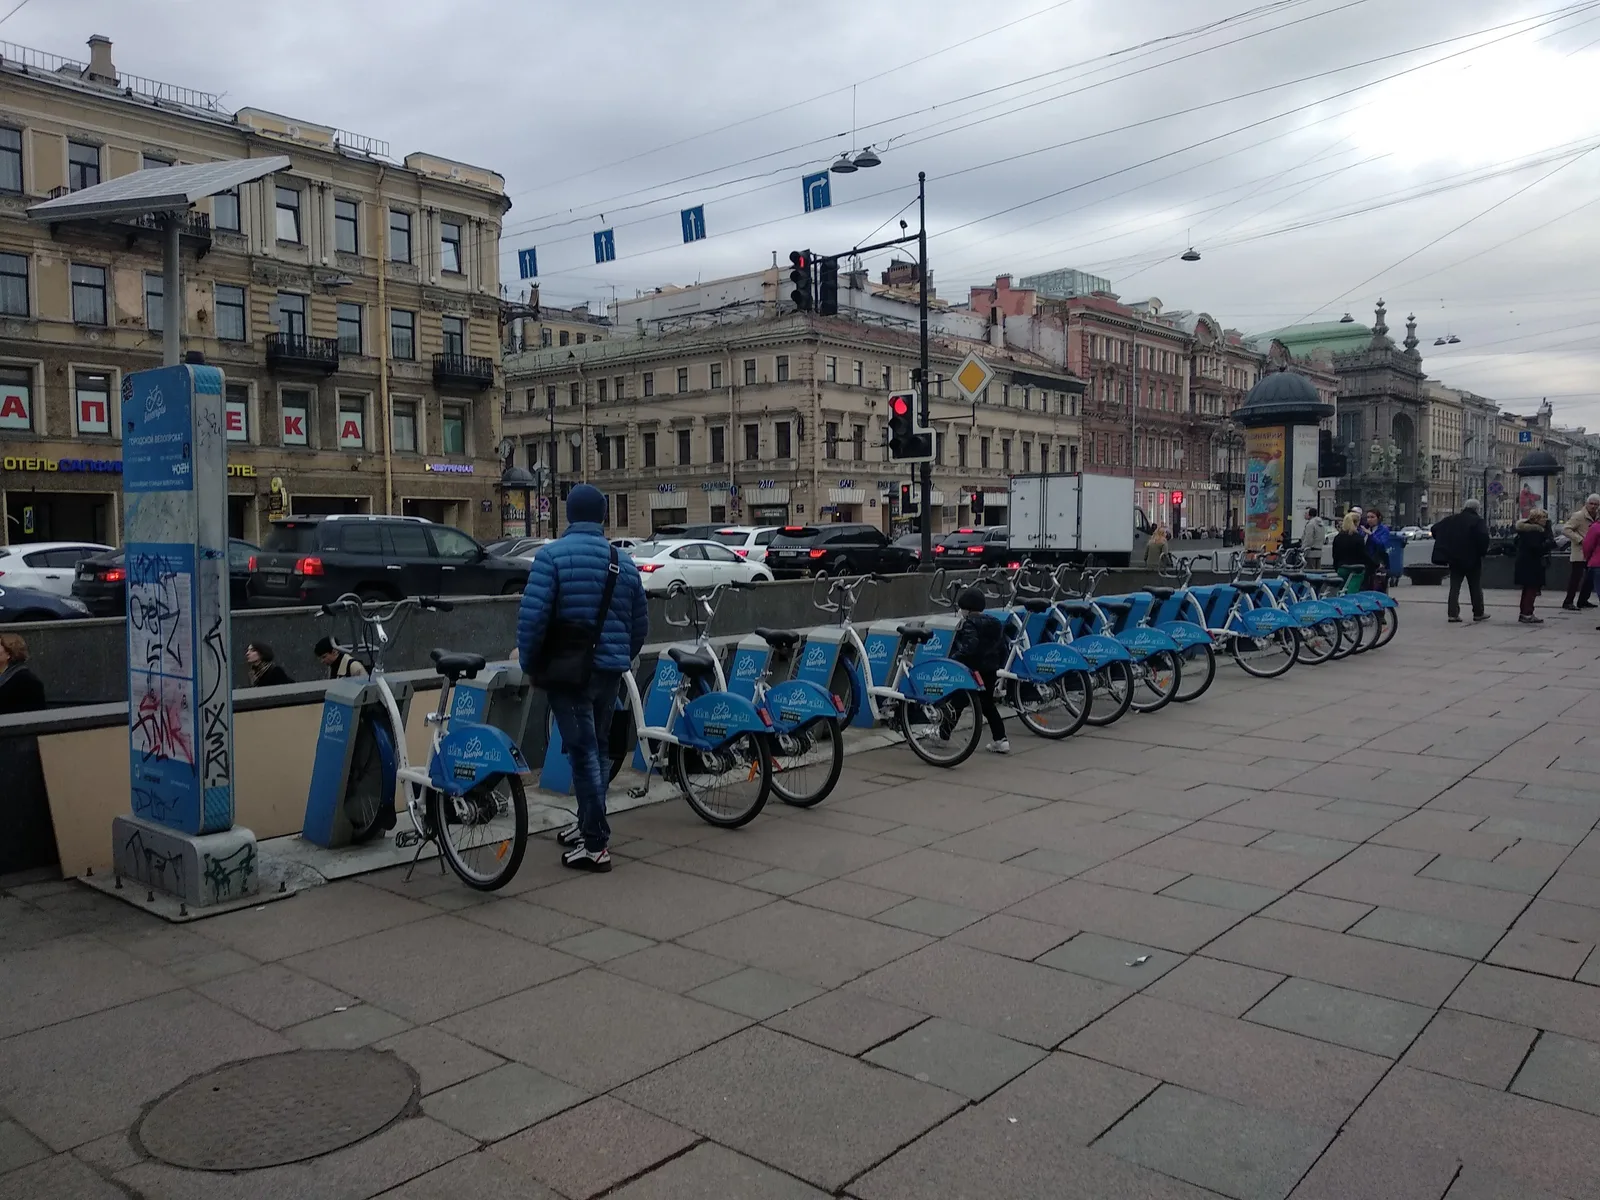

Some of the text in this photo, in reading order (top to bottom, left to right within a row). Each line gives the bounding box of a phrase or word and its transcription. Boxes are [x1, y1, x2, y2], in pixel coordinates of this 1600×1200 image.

[4, 456, 58, 471] ОТЕЛЬ
[59, 458, 123, 472] САПФИ
[228, 464, 257, 477] OTEL
[657, 484, 678, 493] CAFE
